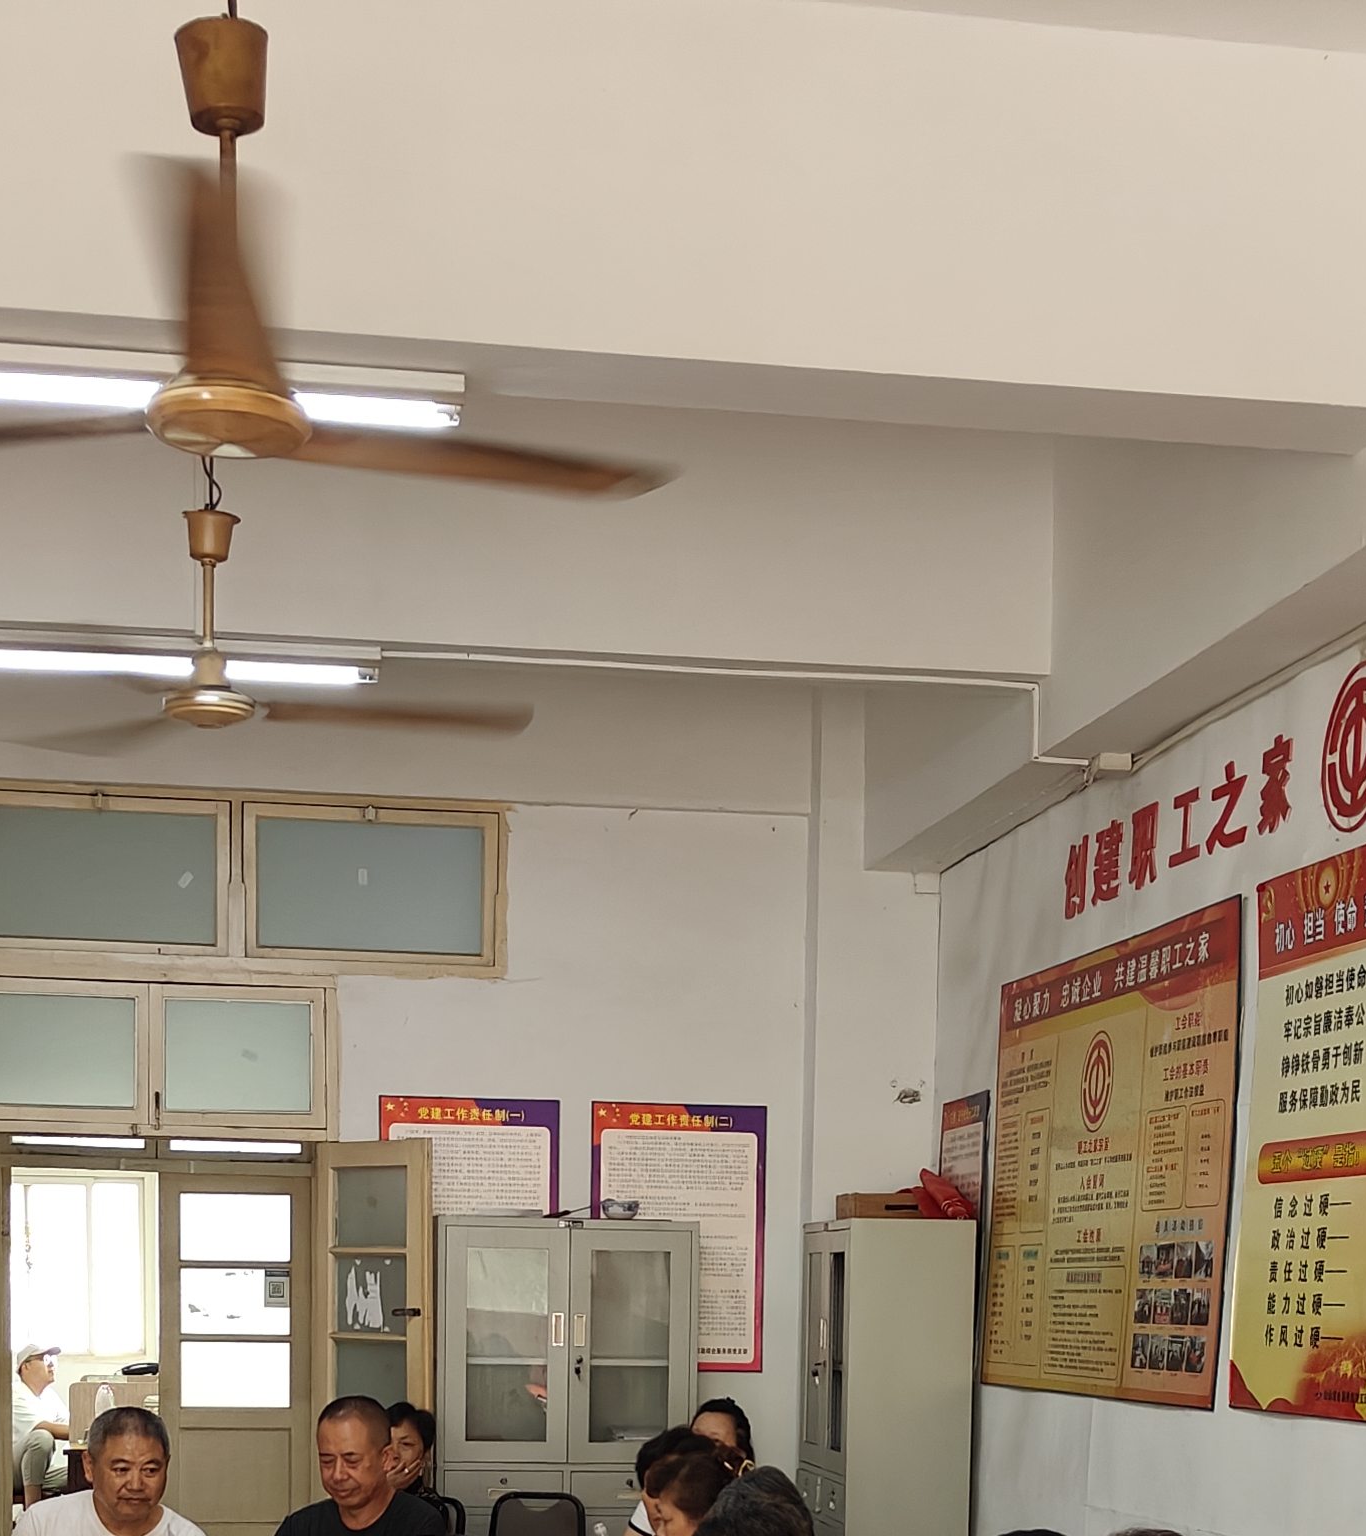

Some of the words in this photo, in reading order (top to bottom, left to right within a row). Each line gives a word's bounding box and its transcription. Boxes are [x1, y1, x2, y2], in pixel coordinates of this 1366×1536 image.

[1064, 734, 1294, 920] 创建职工之家
[1275, 920, 1295, 954] 初心
[1303, 907, 1324, 946] 担当
[1334, 899, 1357, 936] 使命
[1013, 989, 1050, 1024] 凝心聚力
[1061, 971, 1102, 1008] 忠诚企业
[1114, 932, 1210, 991] 共建温馨职工之家
[1285, 964, 1366, 1006] 初心如磐担当使命
[1284, 1003, 1365, 1043] 牢记宗旨廉洁奉公
[1281, 1040, 1364, 1078] 铮铮铁骨勇于创新
[1278, 1079, 1360, 1114] 服务保障勤政为民
